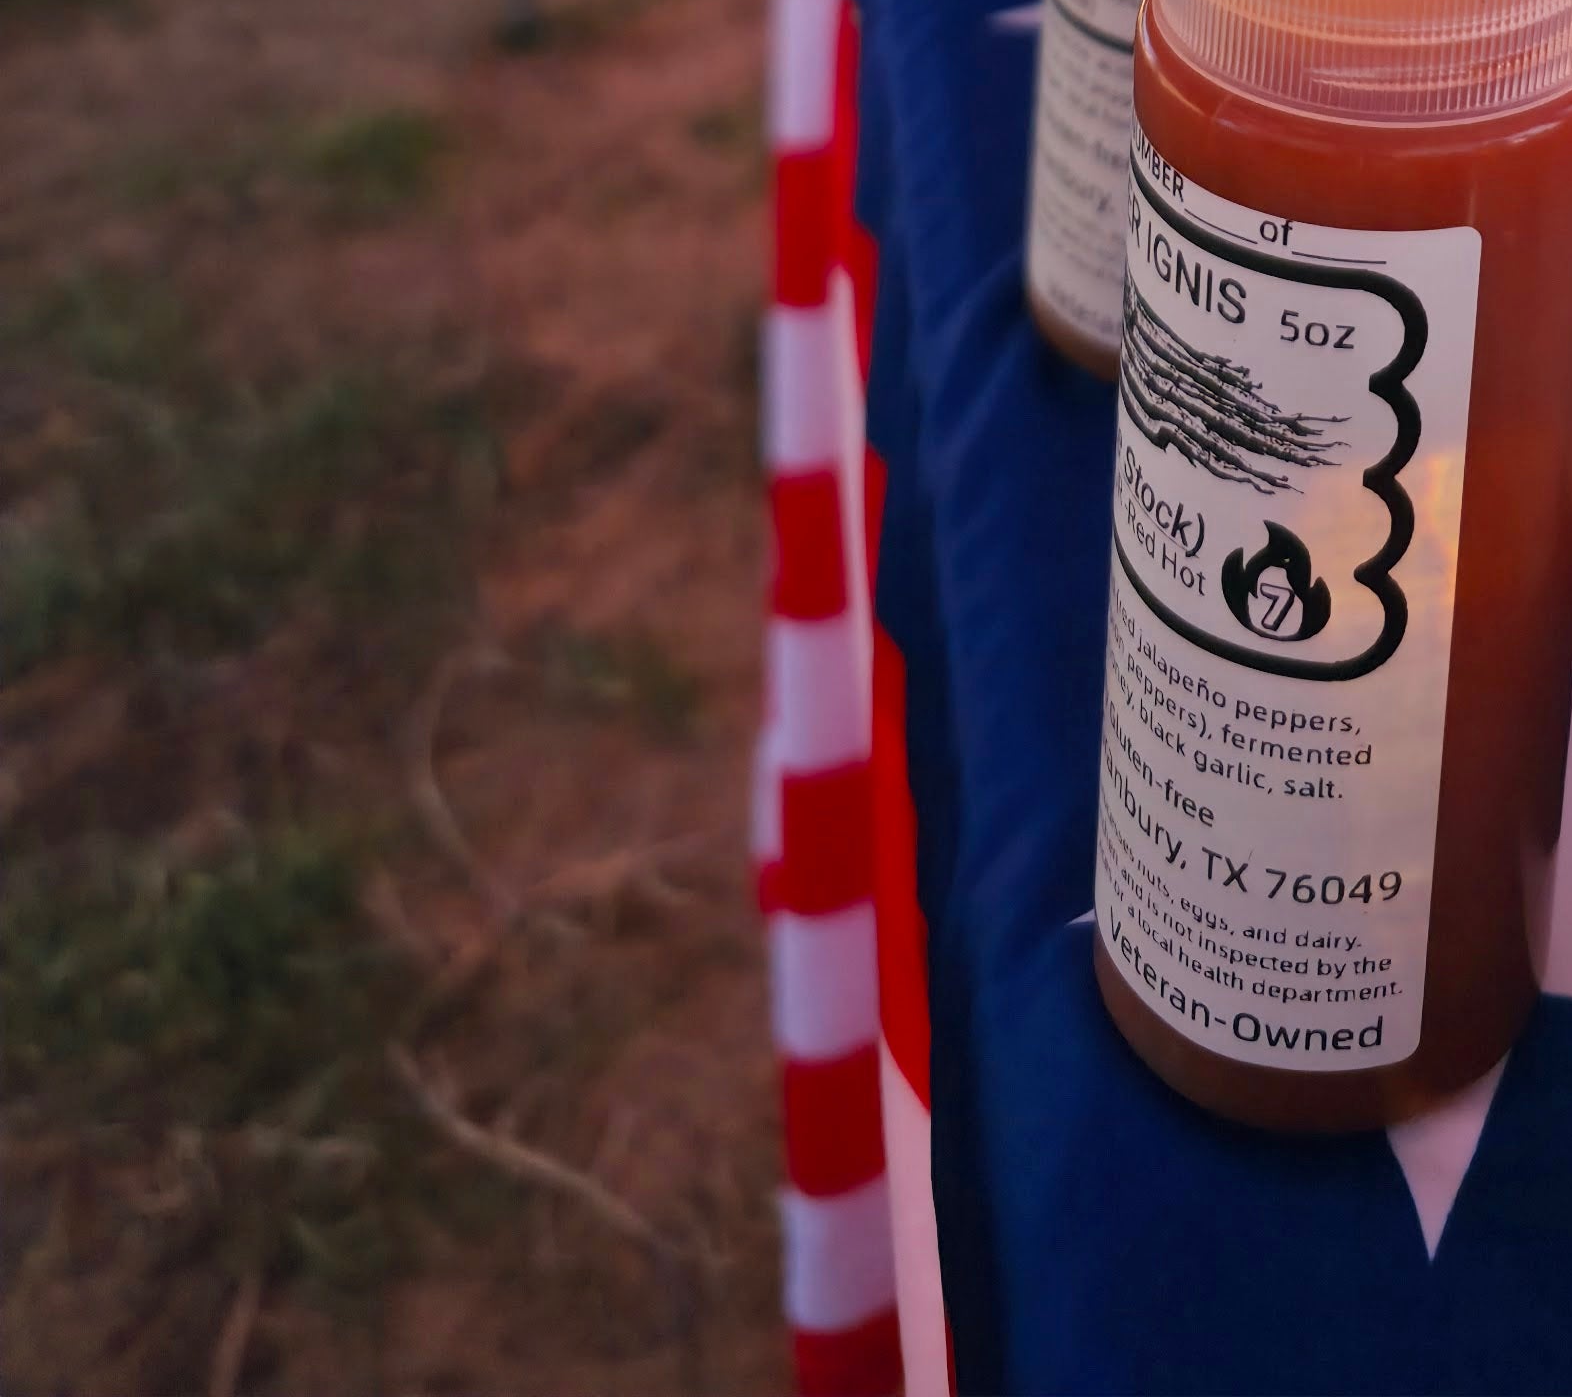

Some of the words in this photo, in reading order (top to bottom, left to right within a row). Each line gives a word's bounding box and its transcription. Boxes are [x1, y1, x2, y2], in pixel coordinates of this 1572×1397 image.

[1147, 221, 1247, 325] IGNIS
[1279, 308, 1356, 350] 5oz
[1259, 219, 1293, 247] of
[1124, 445, 1206, 558] Stock)
[1161, 543, 1207, 596] Hot
[1128, 653, 1212, 741] peppers),
[1221, 724, 1373, 766] fermented
[1137, 628, 1227, 708] jalapeño
[1236, 700, 1361, 736] peppers,
[1109, 700, 1215, 827] Gluten-free
[1140, 697, 1186, 757] black
[1193, 750, 1273, 795] garlic,
[1284, 776, 1344, 800] salt.
[1104, 737, 1186, 871] ranbury,
[1202, 846, 1249, 894] TX
[1264, 868, 1402, 906] 76049
[1127, 905, 1135, 918] a
[1137, 908, 1174, 956] local
[1178, 944, 1244, 992] health
[1251, 979, 1403, 1004] department.
[1137, 859, 1174, 905] nuts,
[1180, 897, 1235, 936] eggs,
[1242, 926, 1287, 944] and
[1295, 930, 1362, 952] dairy.
[1147, 892, 1159, 917] is
[1163, 912, 1193, 943] not
[1198, 931, 1309, 976] inspected
[1316, 958, 1347, 980] by
[1353, 956, 1392, 975] the
[1110, 905, 1384, 1052] Veteran-Owned
